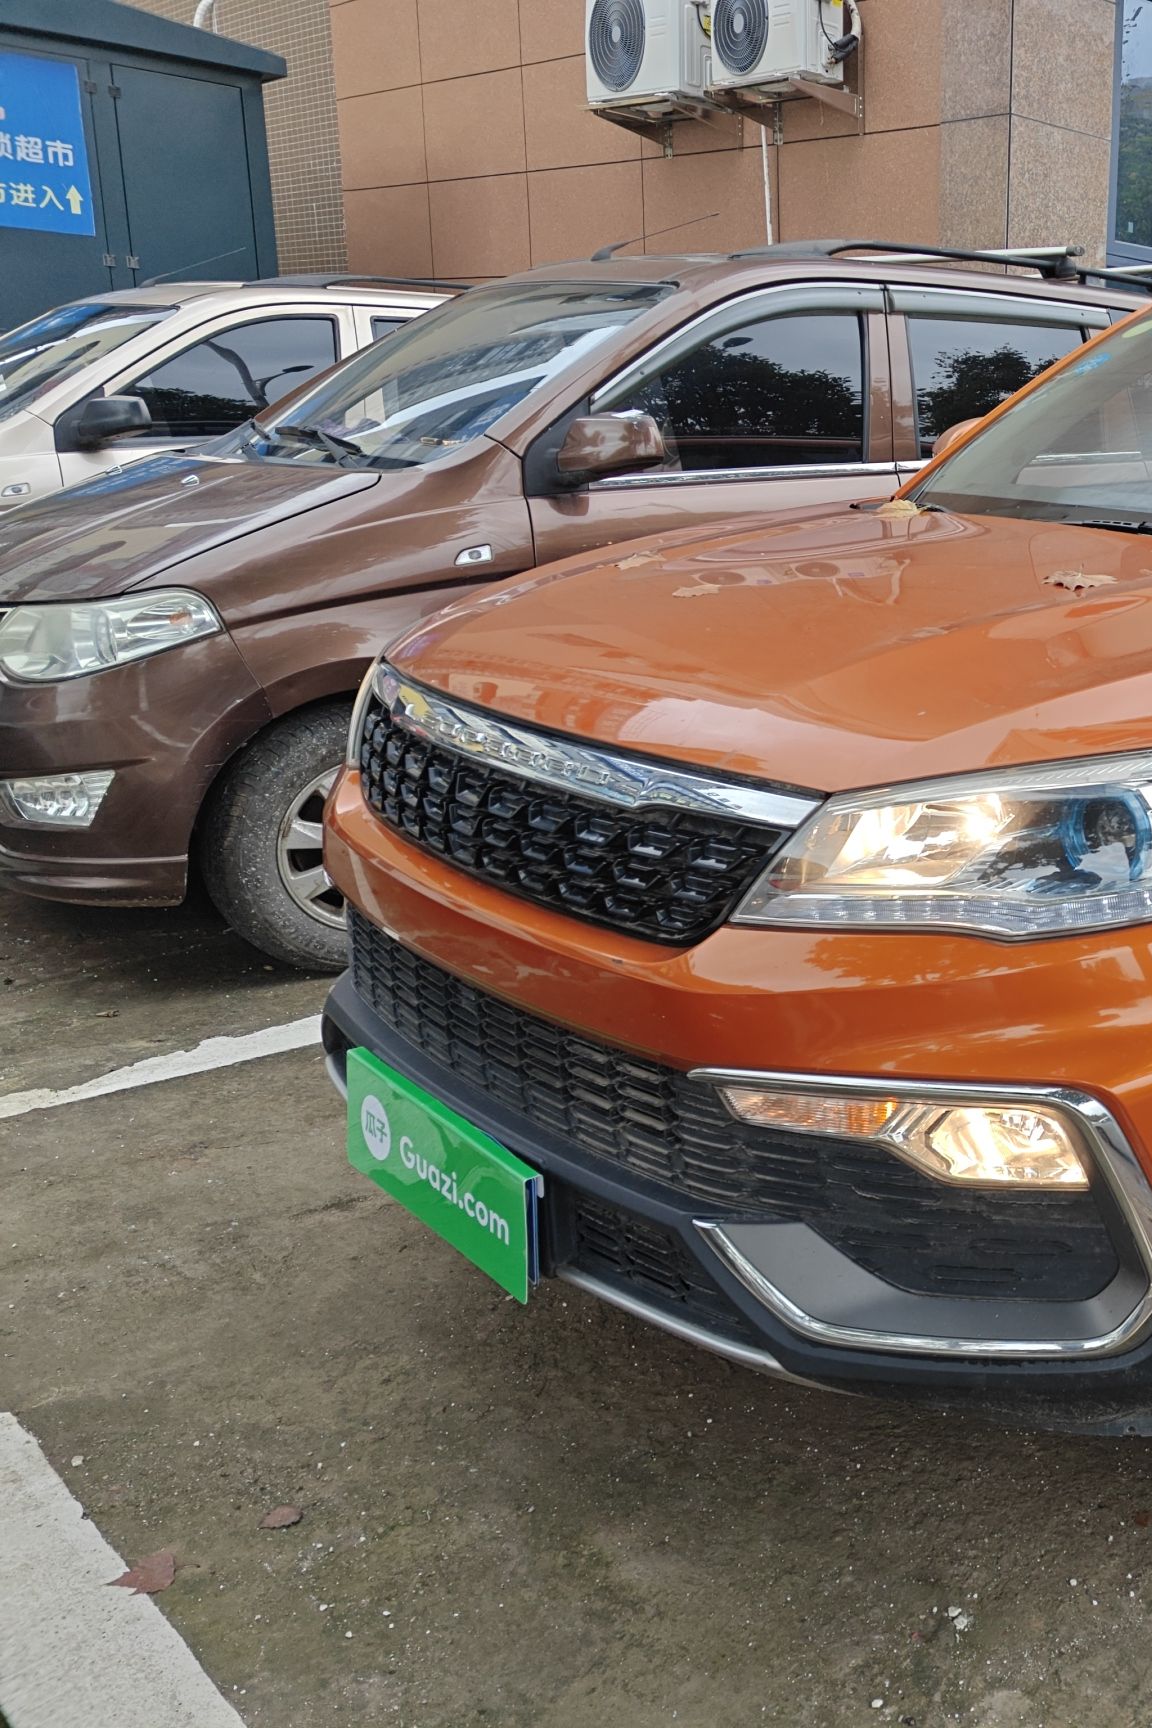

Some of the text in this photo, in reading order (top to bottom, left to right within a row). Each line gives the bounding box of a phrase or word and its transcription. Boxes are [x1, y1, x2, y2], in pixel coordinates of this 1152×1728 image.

[0, 182, 64, 211] 进入
[365, 1109, 388, 1143] 瓜子
[399, 1135, 510, 1246] Guazi.com
